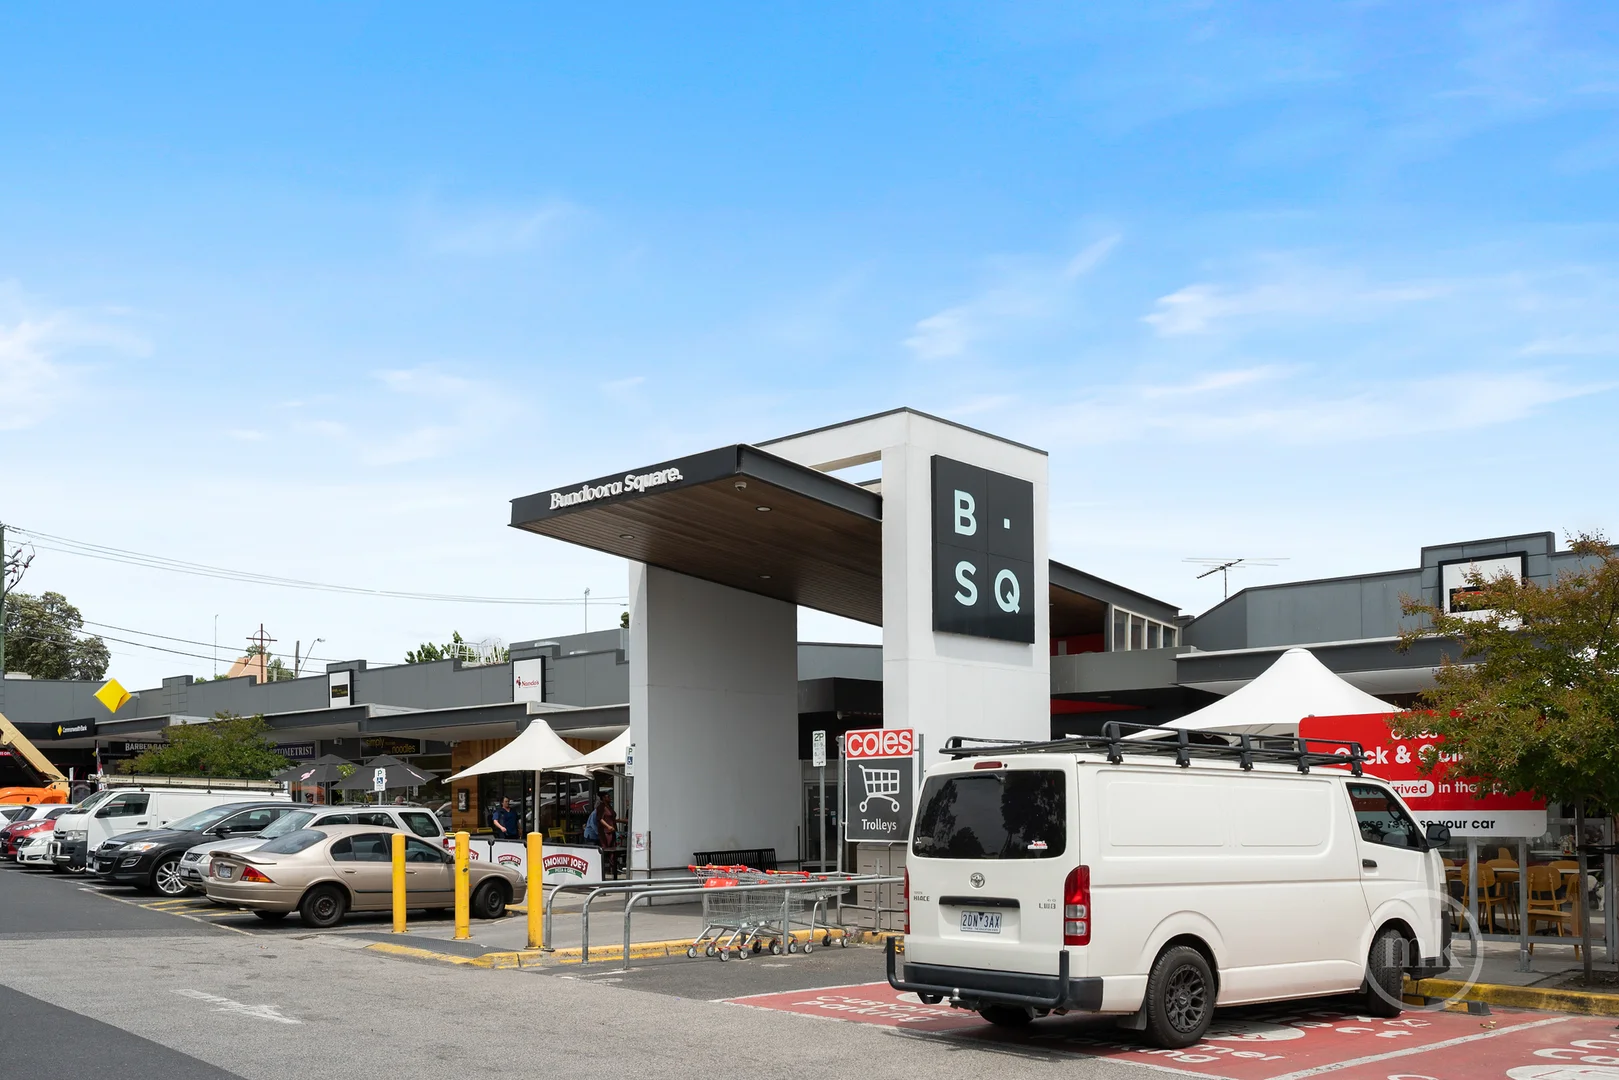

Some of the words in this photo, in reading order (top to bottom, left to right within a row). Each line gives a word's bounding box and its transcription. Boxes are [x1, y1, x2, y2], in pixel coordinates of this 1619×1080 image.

[550, 482, 623, 510] Bundoora
[814, 732, 824, 741] 2P
[847, 730, 912, 756] coles
[392, 744, 416, 753] noodles
[1395, 745, 1411, 764] &
[1438, 782, 1451, 793] in
[861, 818, 897, 833] Trolleys
[1471, 820, 1496, 829] car
[570, 857, 587, 871] JOE'S
[983, 914, 1000, 929] 3AX
